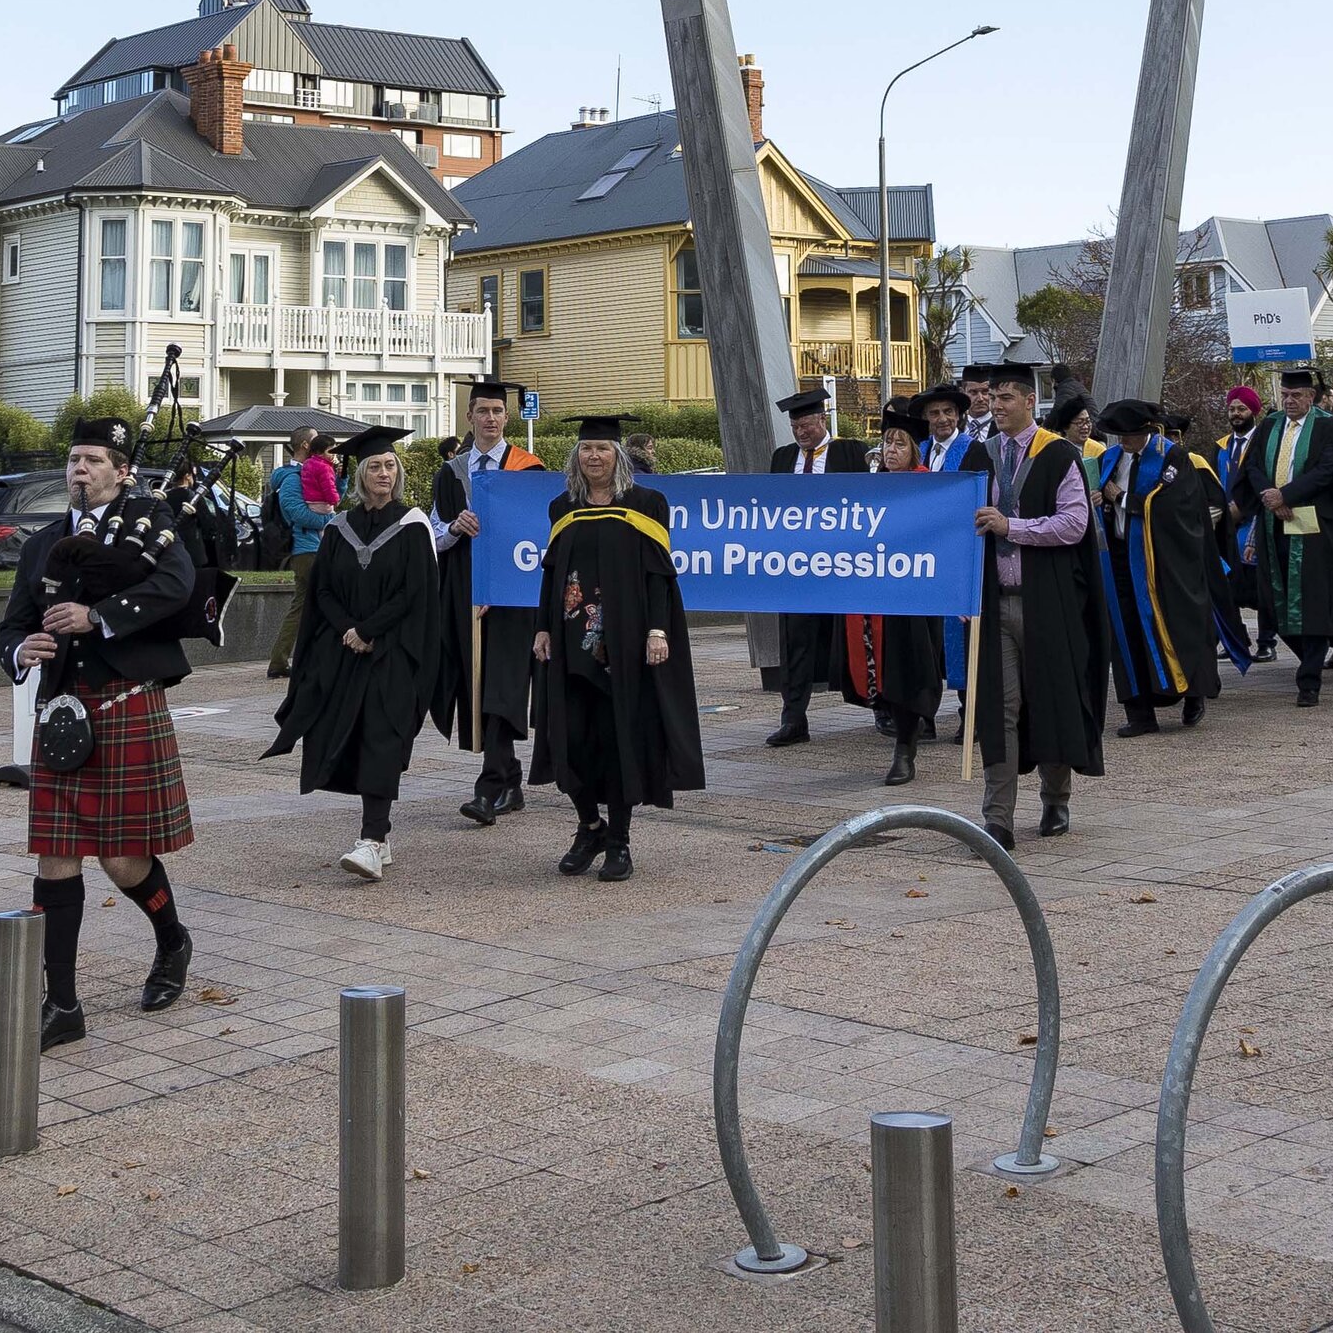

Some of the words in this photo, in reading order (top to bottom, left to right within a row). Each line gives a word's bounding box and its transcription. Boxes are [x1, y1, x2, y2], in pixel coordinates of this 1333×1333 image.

[1253, 313, 1281, 325] PhD's
[701, 498, 887, 537] University
[723, 543, 935, 578] Procession
